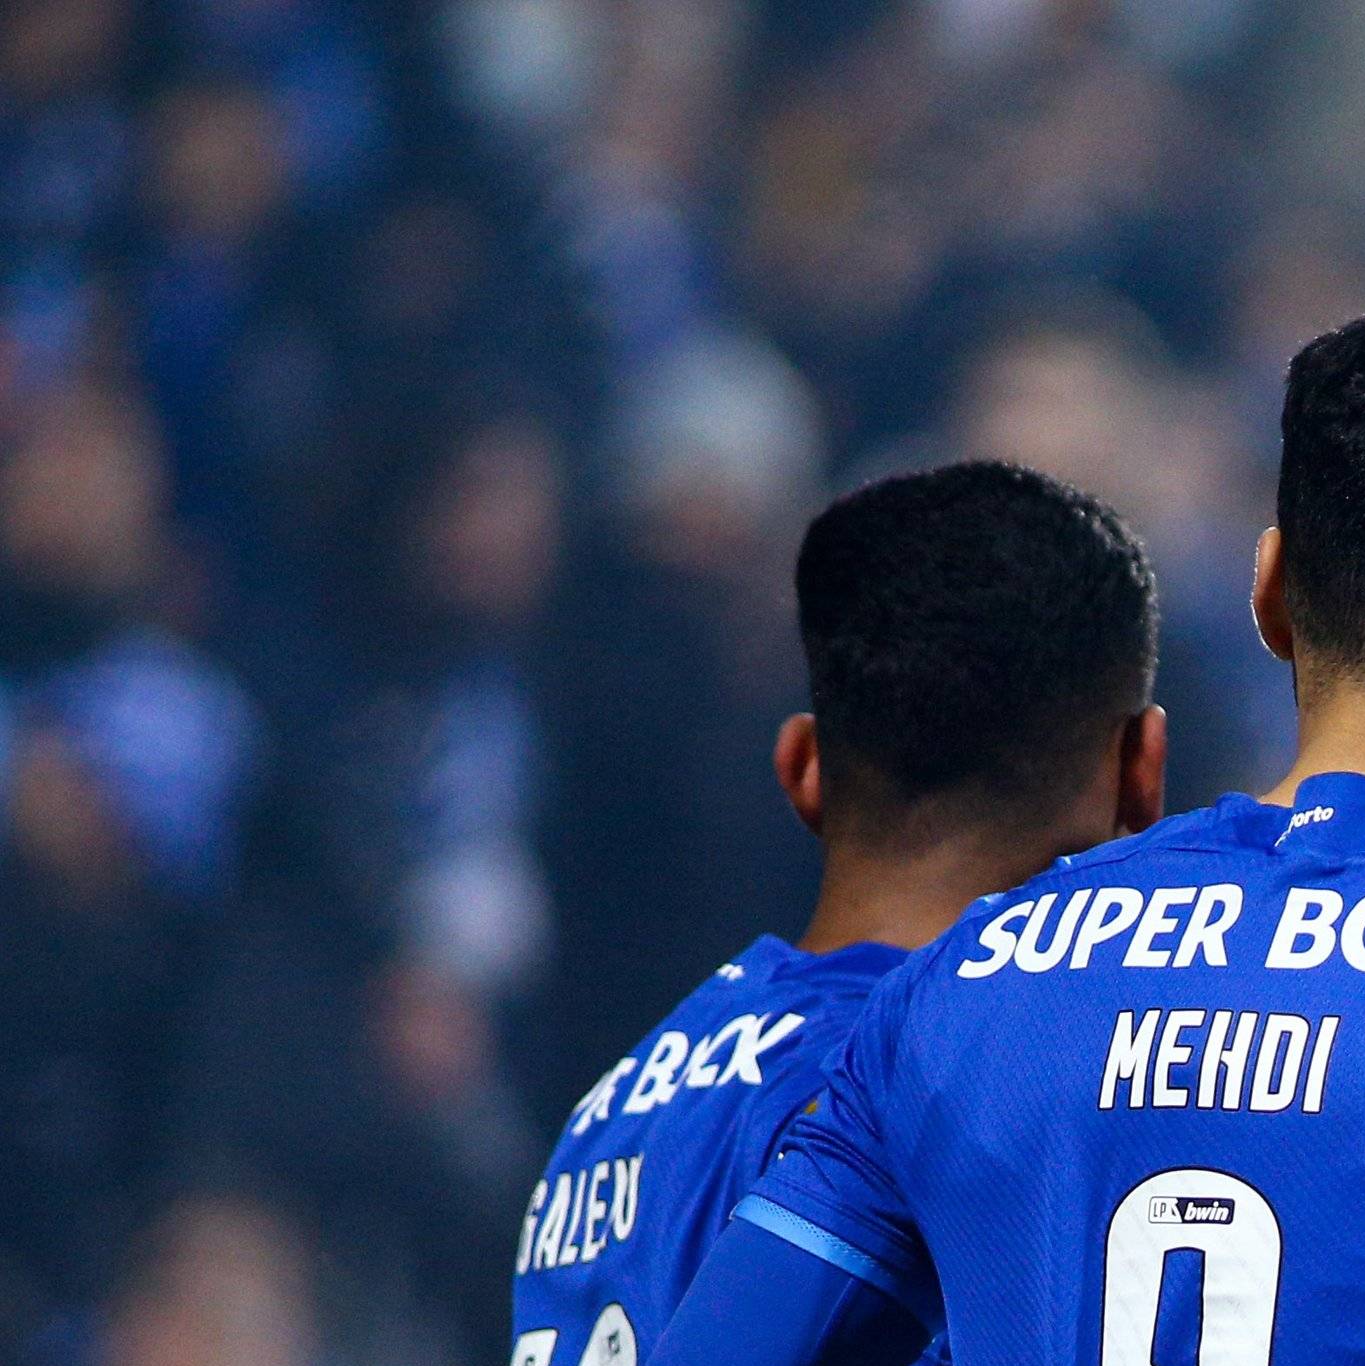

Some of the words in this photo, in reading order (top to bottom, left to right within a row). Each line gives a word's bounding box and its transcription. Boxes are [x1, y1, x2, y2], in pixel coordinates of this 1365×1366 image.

[956, 883, 1245, 980] SUPER
[1097, 1008, 1341, 1115] MEHDI
[1184, 1201, 1229, 1221] bwin
